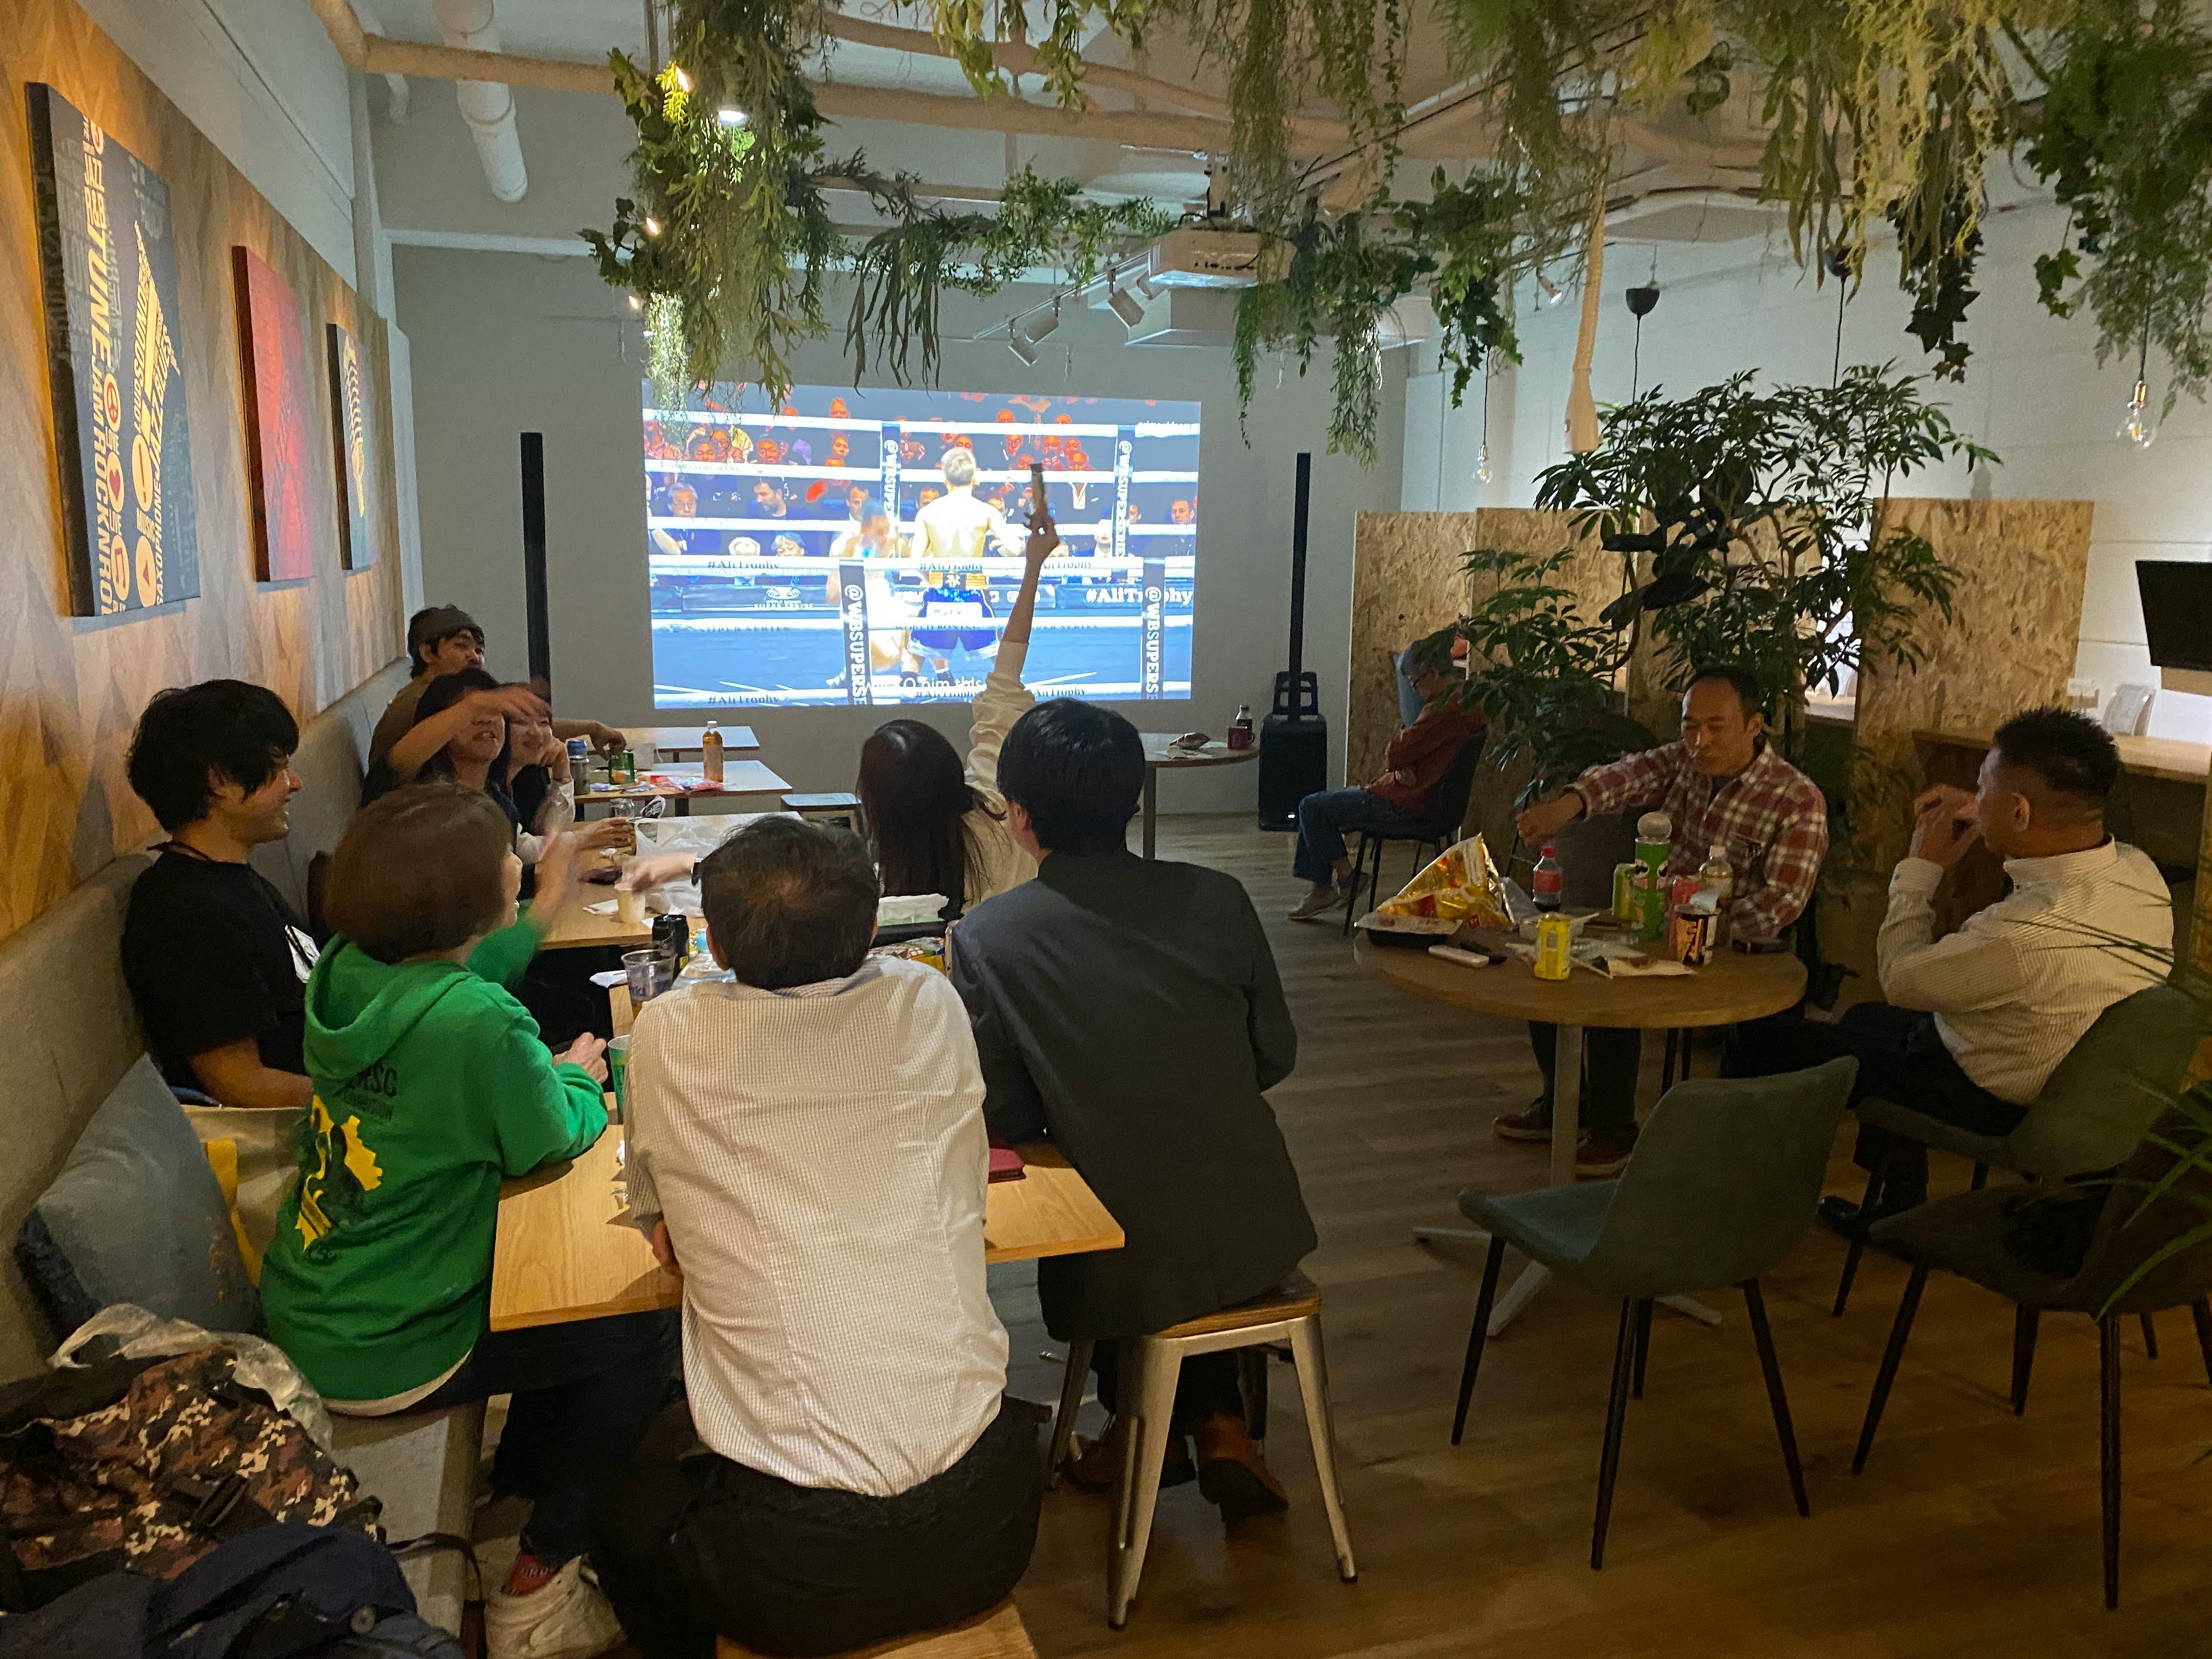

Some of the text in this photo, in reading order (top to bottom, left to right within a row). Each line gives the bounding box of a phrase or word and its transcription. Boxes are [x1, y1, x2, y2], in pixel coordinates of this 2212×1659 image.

[84, 154, 104, 192] JAZZ
[84, 186, 107, 230] R&B
[87, 223, 111, 369] TUNE
[134, 283, 149, 384] SOUND
[92, 355, 104, 427] JAM
[150, 324, 172, 605] SAXOPHONE JAZZ BLUES
[137, 507, 154, 539] MUSIC
[707, 560, 780, 569] #AliTrophy
[708, 694, 780, 704] #AliTrophy
